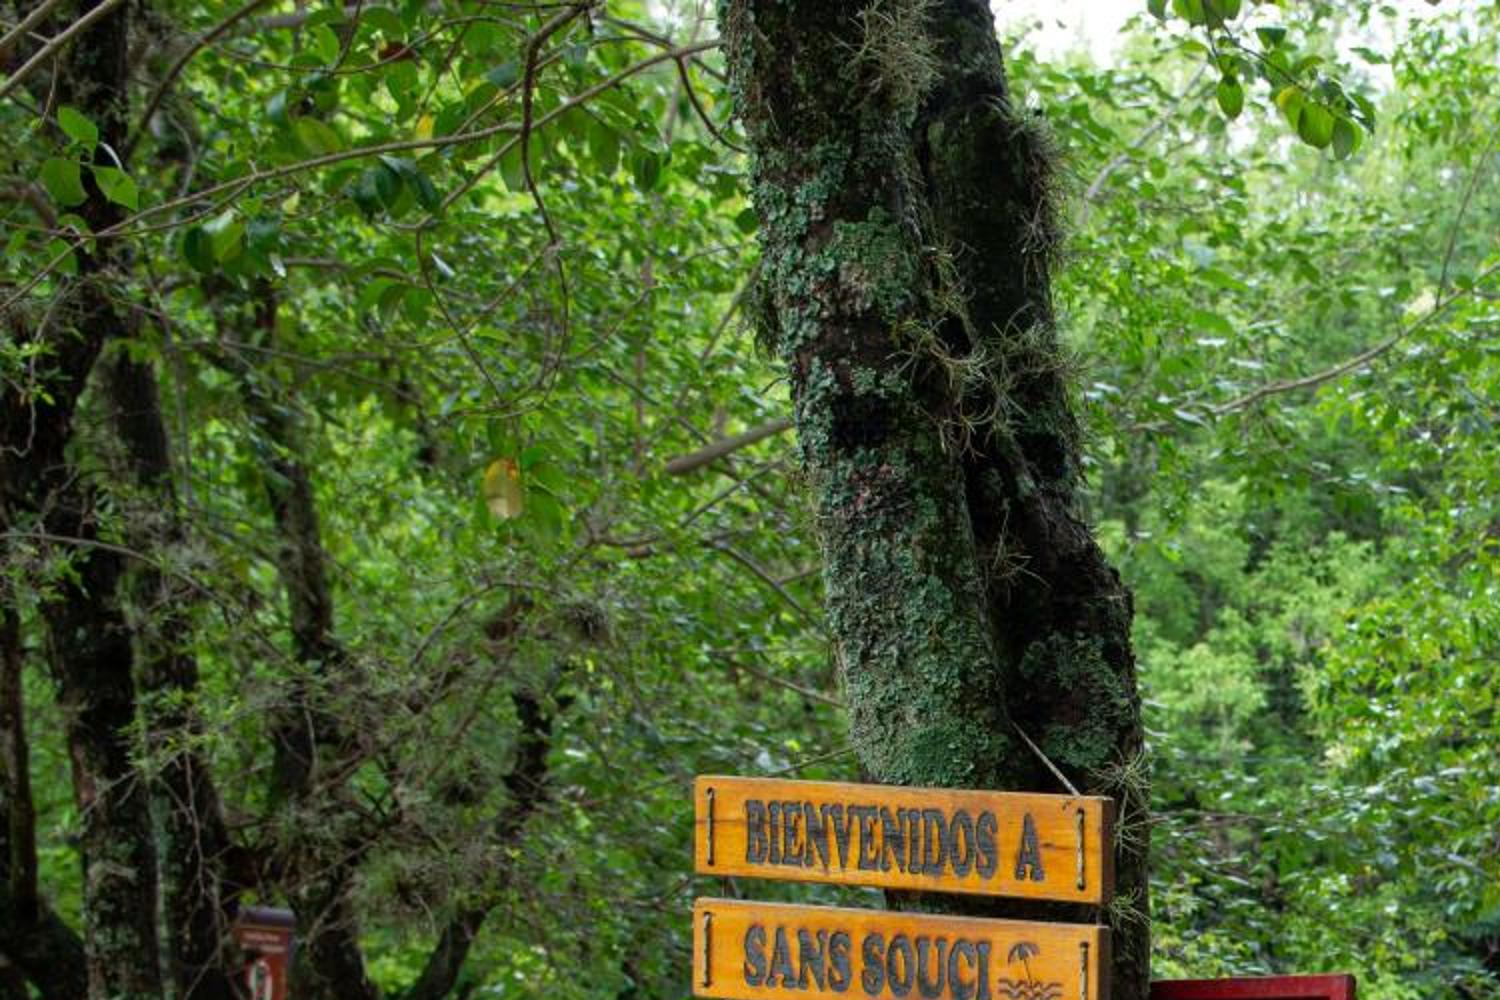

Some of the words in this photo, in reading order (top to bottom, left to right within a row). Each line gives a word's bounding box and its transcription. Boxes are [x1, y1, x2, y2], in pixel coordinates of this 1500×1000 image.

[746, 799, 998, 880] BIENVENIDOS
[1014, 812, 1046, 882] A
[743, 924, 851, 993] SANS
